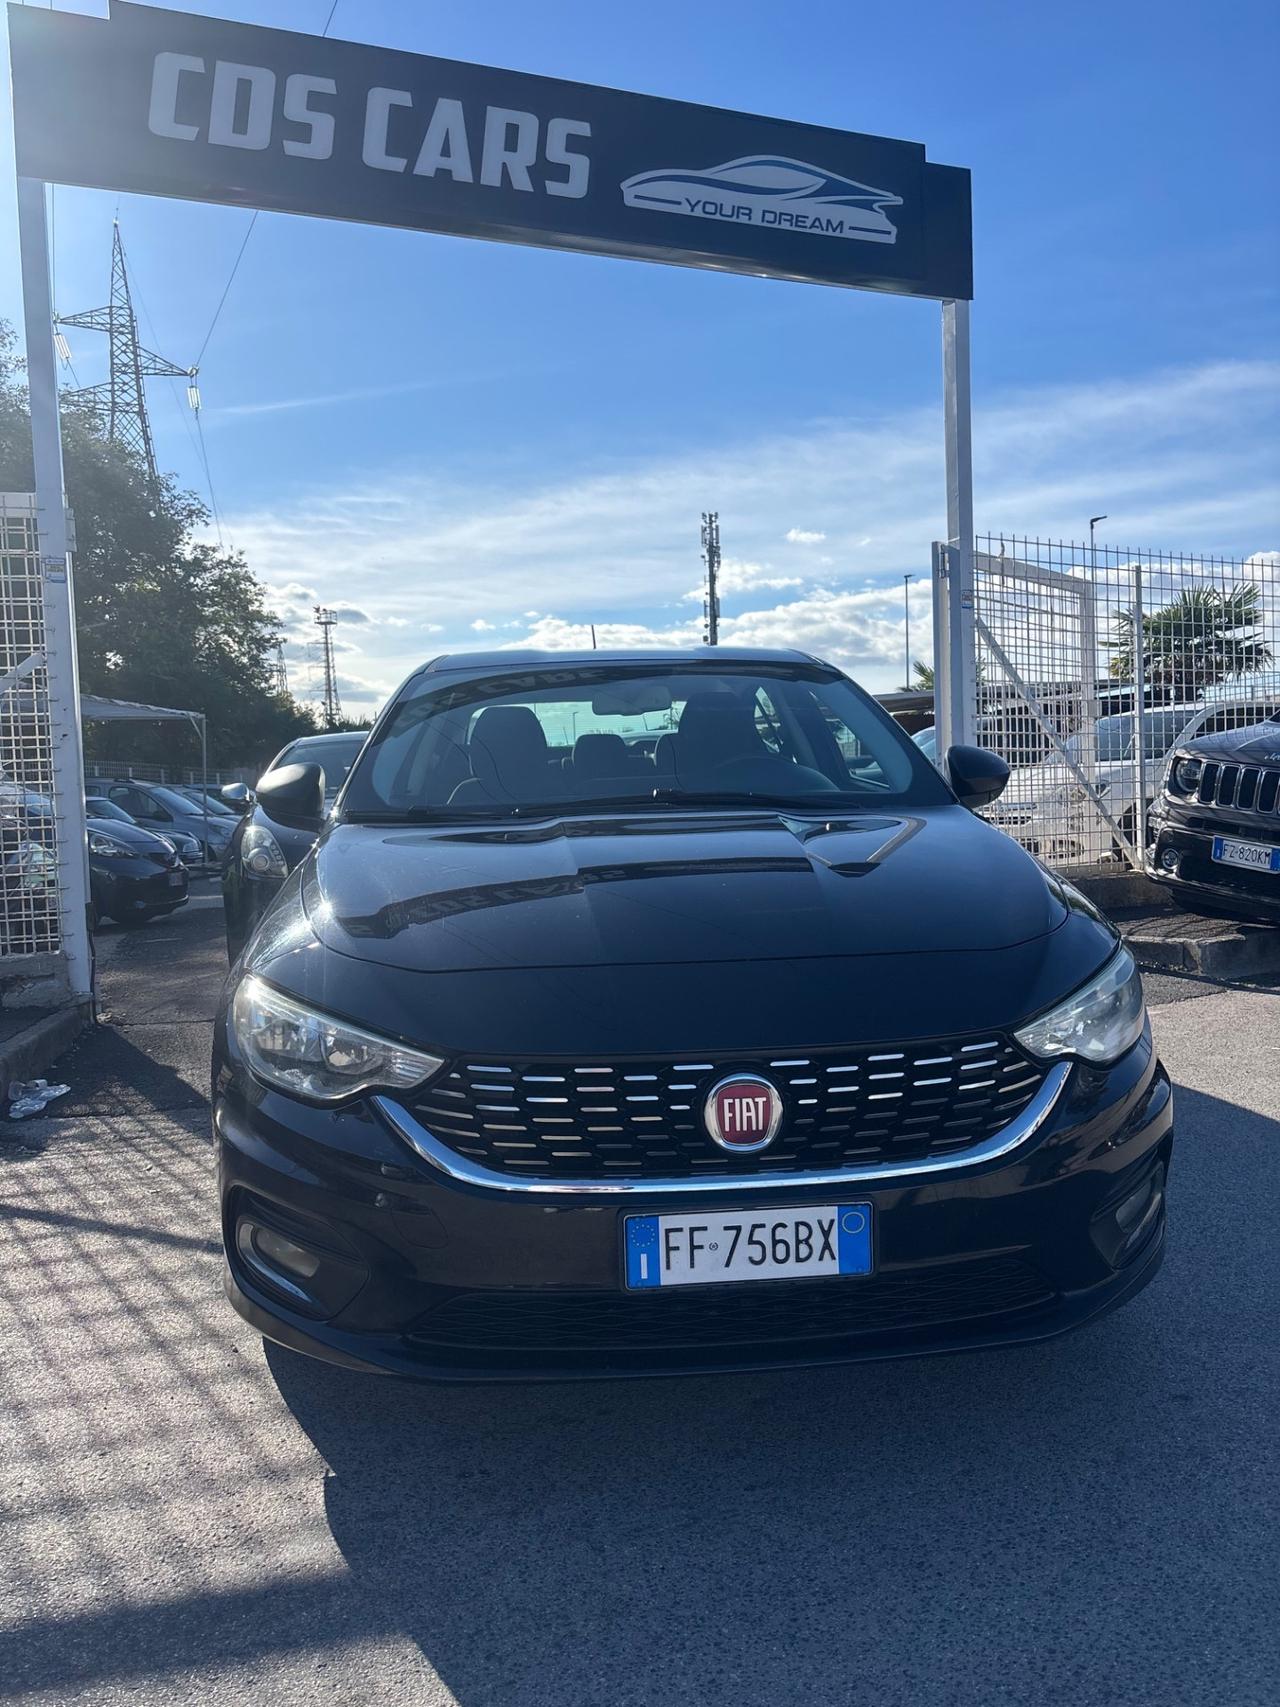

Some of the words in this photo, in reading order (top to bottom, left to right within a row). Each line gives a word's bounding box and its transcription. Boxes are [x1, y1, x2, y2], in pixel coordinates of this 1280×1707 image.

[148, 52, 338, 160] CDS
[362, 87, 592, 199] CARS
[685, 198, 752, 221] YOUR
[761, 209, 844, 234] DREAM
[723, 1097, 767, 1132] FIAT
